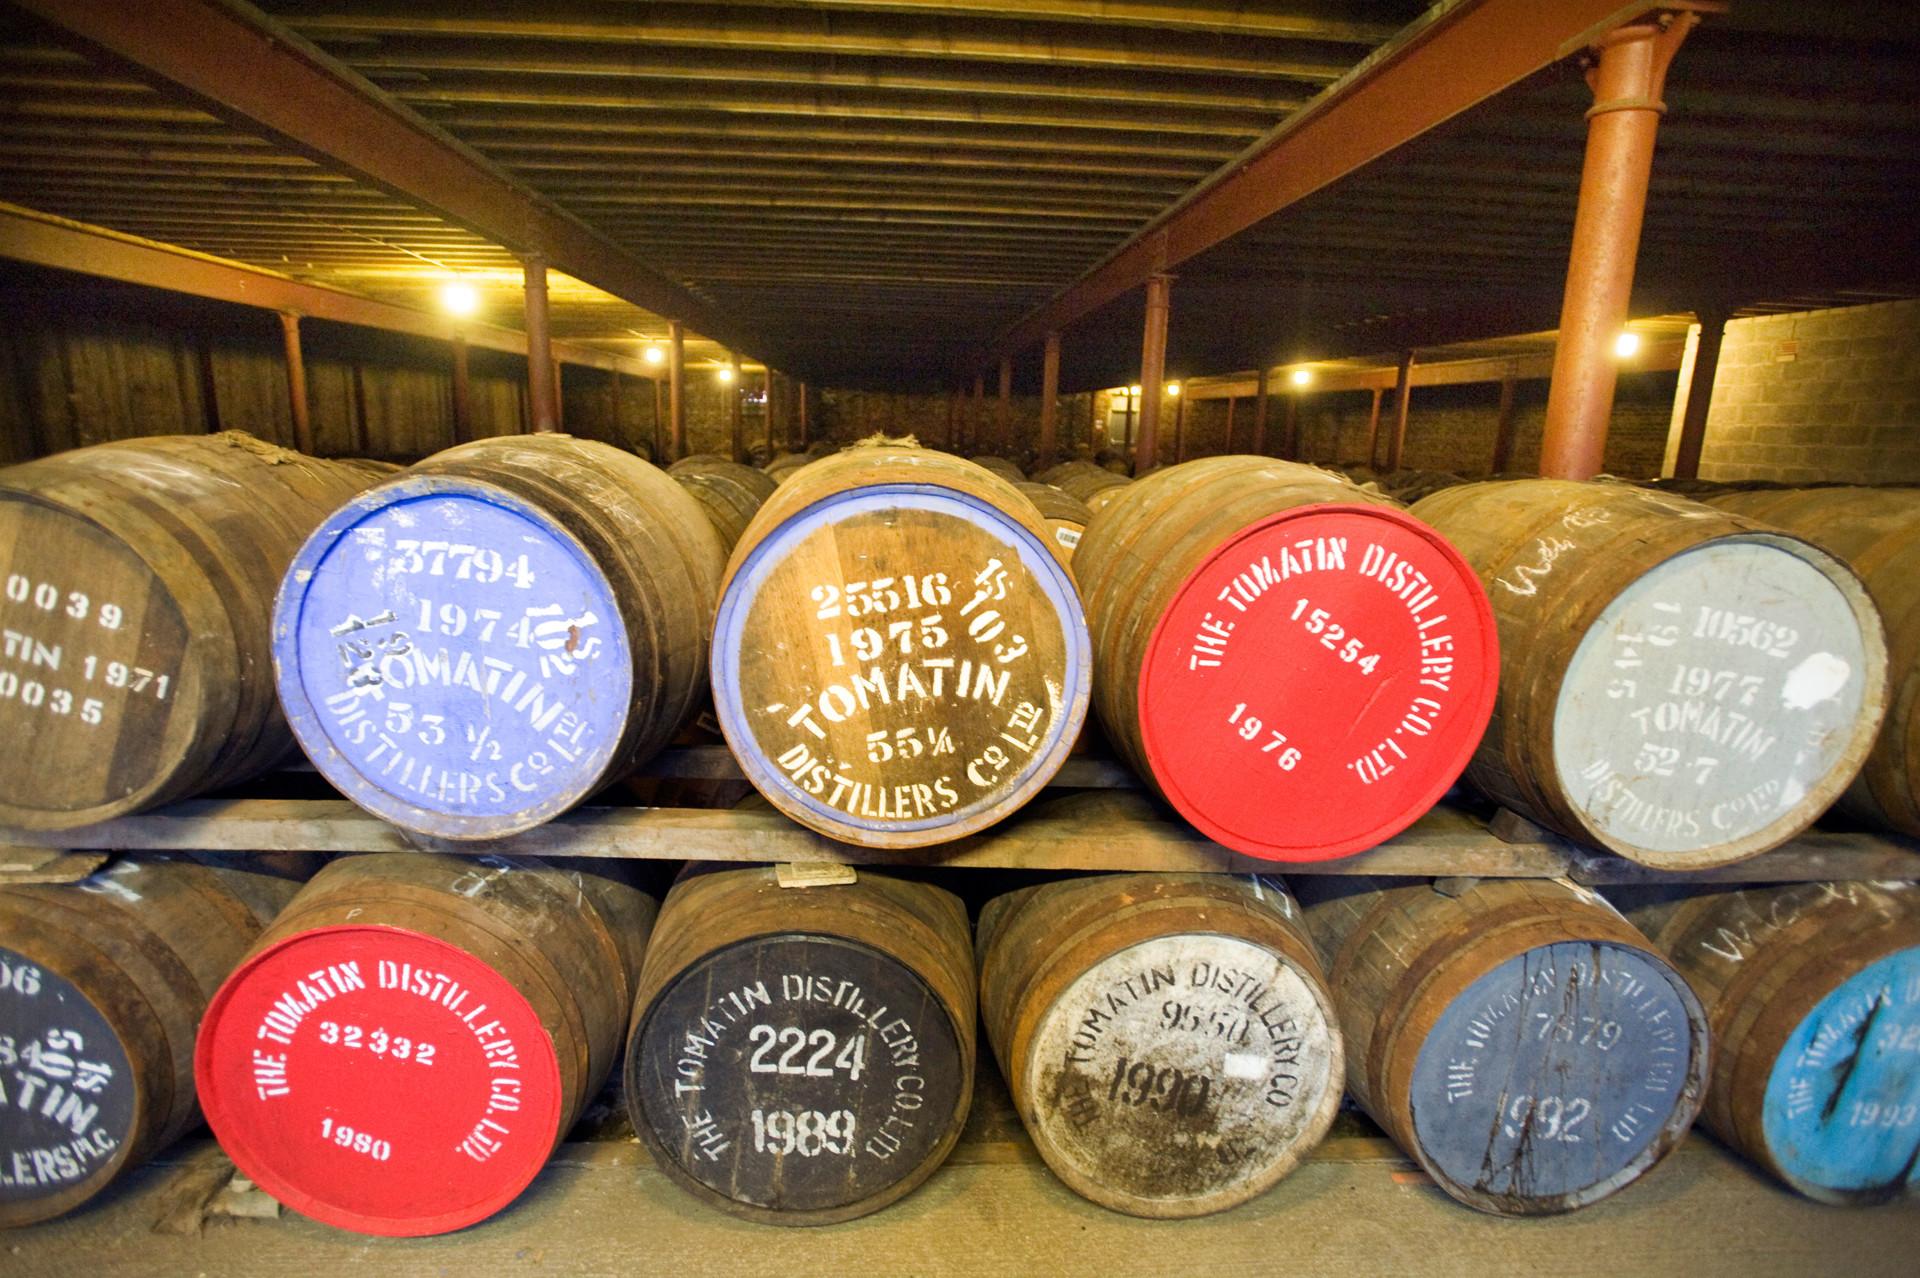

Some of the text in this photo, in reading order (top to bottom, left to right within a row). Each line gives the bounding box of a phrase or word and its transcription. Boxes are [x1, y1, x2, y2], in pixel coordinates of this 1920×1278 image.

[396, 540, 535, 588] 37794
[7, 574, 123, 630] 0039
[416, 599, 534, 649] 1974
[811, 573, 951, 620] 25516
[960, 590, 1028, 663] 103
[1189, 612, 1235, 671] THE
[1218, 537, 1347, 611] TOMATIN
[1359, 543, 1454, 692] DISTILLERY
[3, 629, 169, 699] TIN 1971
[825, 615, 949, 666] 1975
[1291, 598, 1381, 676] 15254
[347, 648, 564, 732] TOMATIN
[787, 657, 1011, 739] TOMATIN
[1667, 664, 1765, 706] 1977
[325, 689, 505, 803] DISTILLERS
[385, 702, 446, 745] 53
[866, 728, 923, 763] 55
[1227, 702, 1302, 772] 1976
[1630, 700, 1777, 762] TOMATIN
[777, 743, 959, 818] DISTILLERS
[1580, 759, 1701, 838] DISTILLERS
[257, 961, 365, 1044] TOMATIN
[378, 960, 520, 1069] DISTILLERY
[783, 975, 919, 1066] DISTILLERY
[319, 1021, 436, 1065] 32332
[674, 981, 771, 1098] TOMATIN
[749, 1024, 866, 1081] 2224
[1066, 964, 1176, 1063] TOMATIN
[1192, 963, 1300, 1067] DISTILLERY
[1265, 1073, 1298, 1108] CO
[253, 1049, 290, 1100] THE
[1108, 1057, 1210, 1117] 1990
[1448, 1058, 1477, 1103] THE
[321, 1118, 391, 1160] 1980
[682, 1109, 731, 1161] THE
[751, 1109, 856, 1157] 1989
